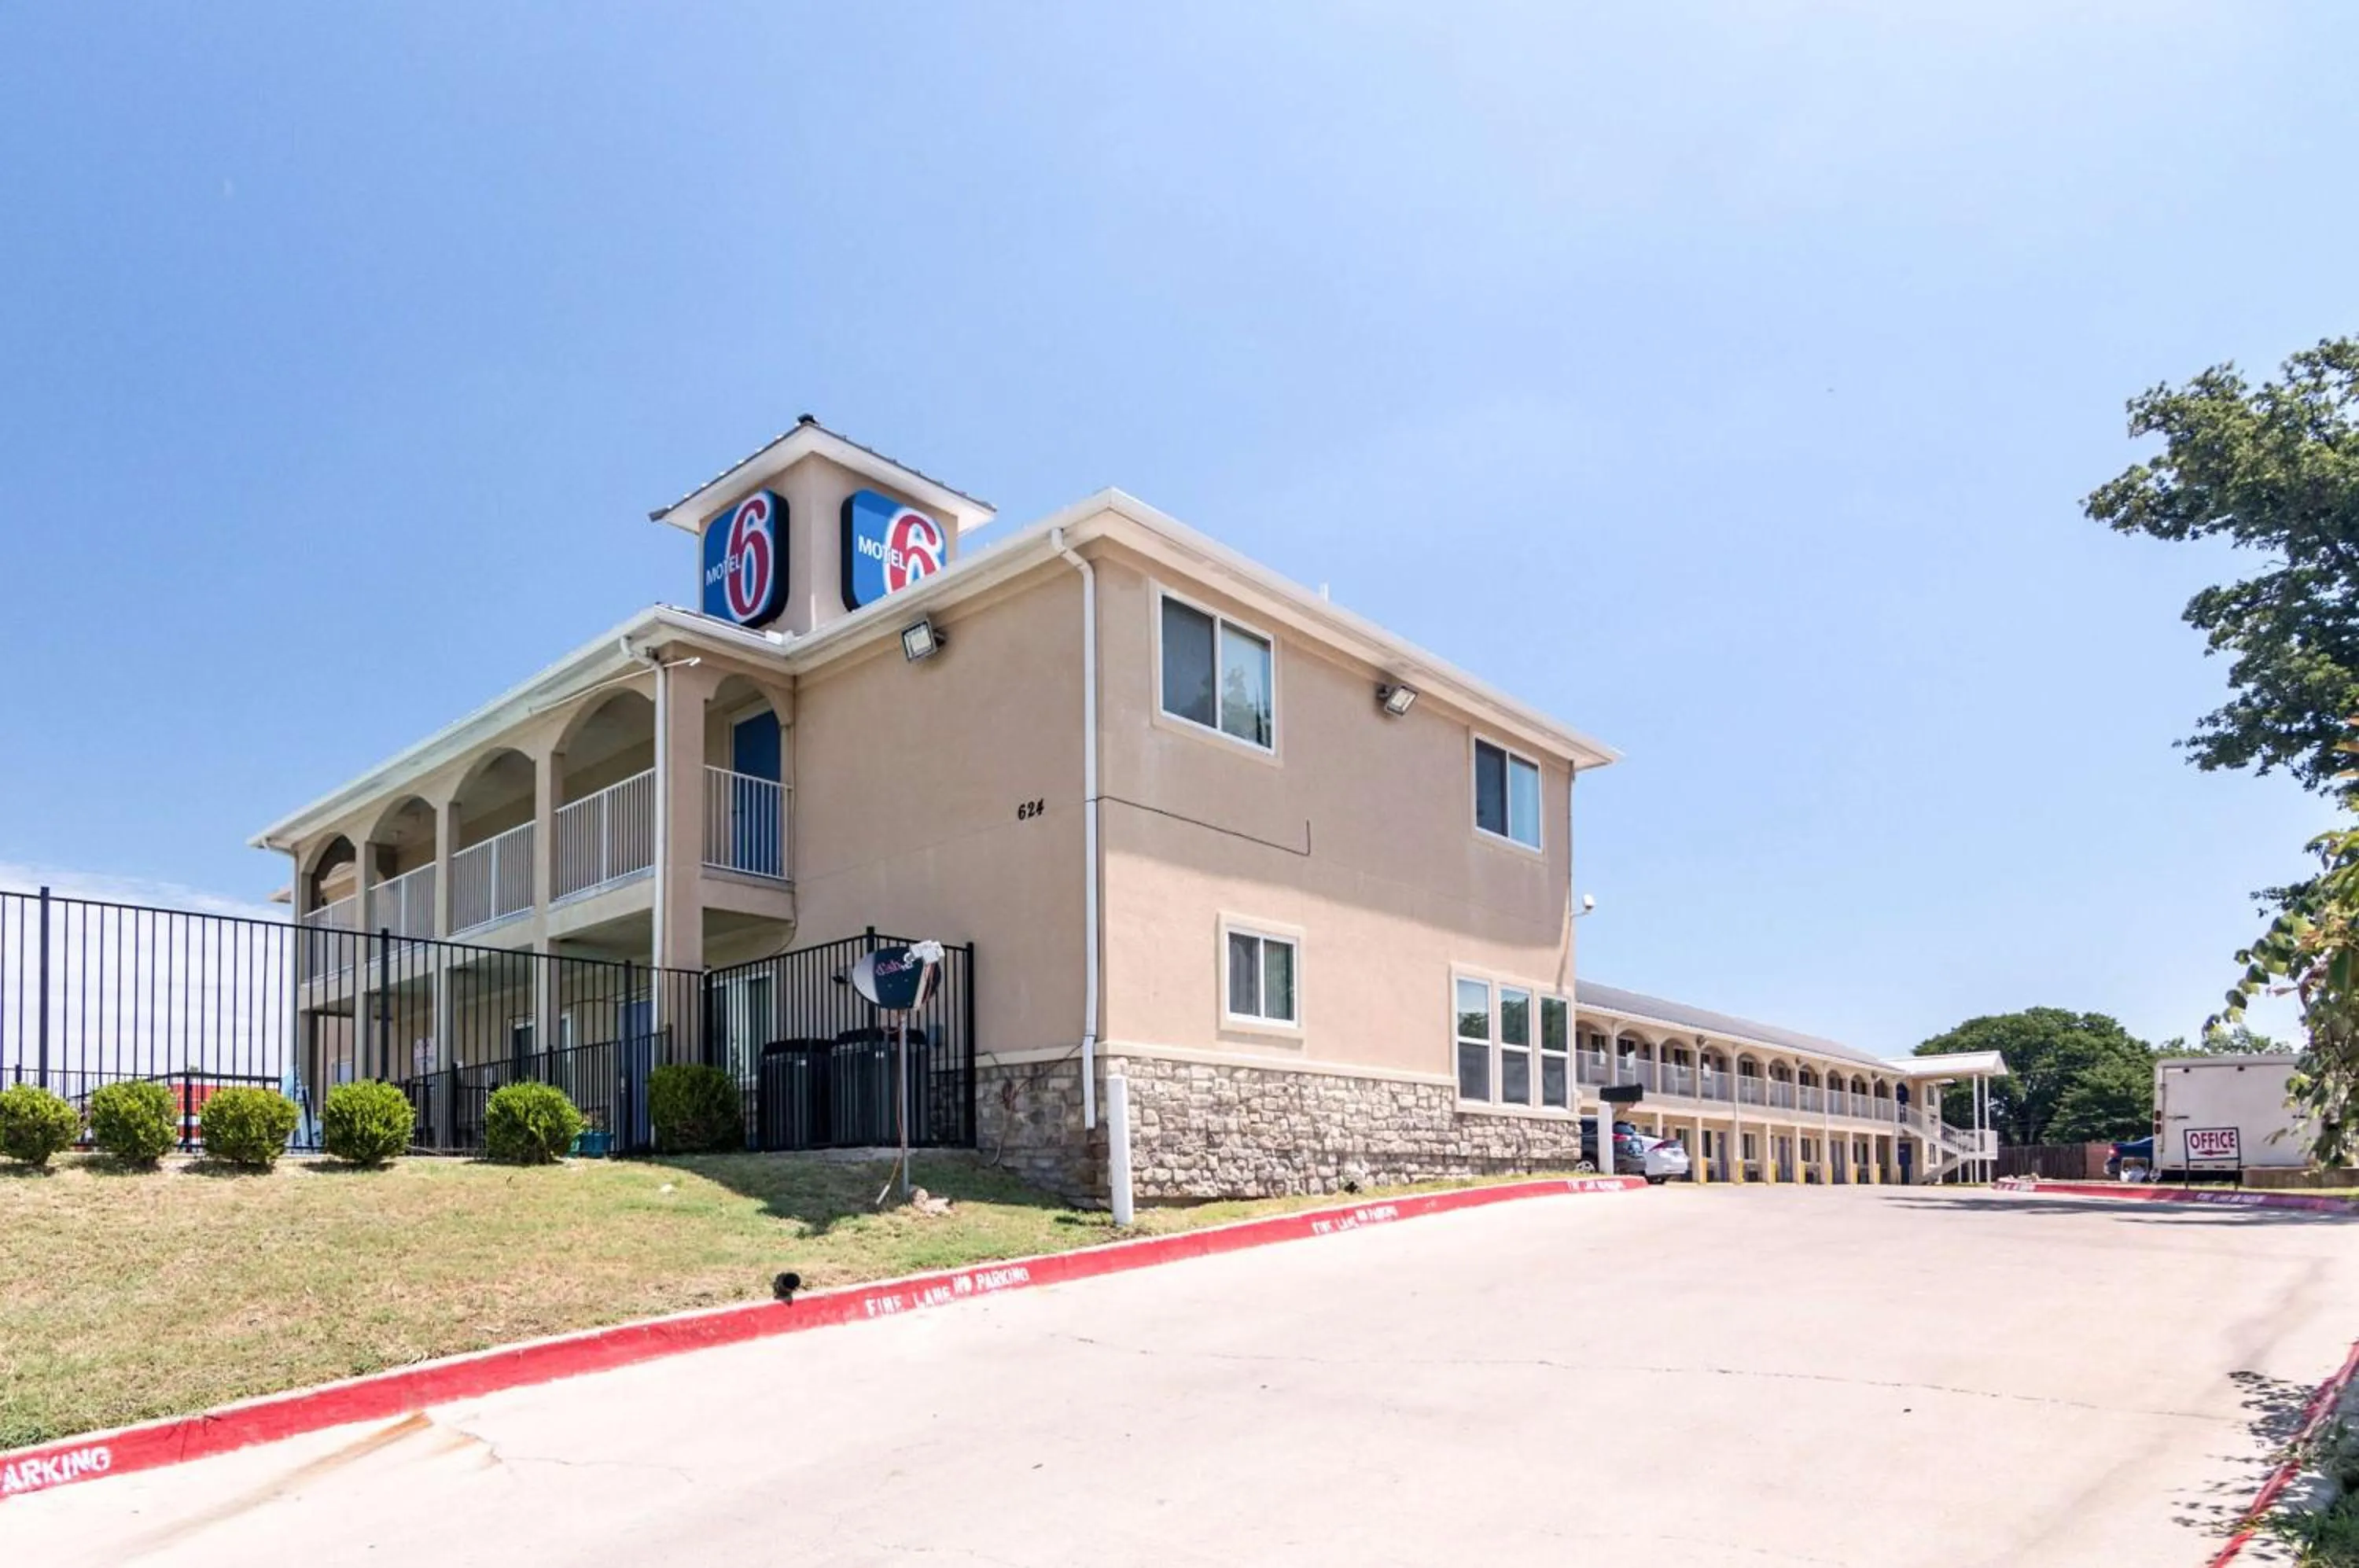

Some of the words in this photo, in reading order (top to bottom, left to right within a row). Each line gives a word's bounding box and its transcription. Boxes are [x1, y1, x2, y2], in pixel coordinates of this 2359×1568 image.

[706, 552, 742, 587] MOTEL
[725, 489, 772, 623] 6
[858, 535, 907, 570] MOTEL
[885, 506, 942, 595] 6
[1018, 798, 1044, 820] 624
[2190, 1132, 2236, 1149] OFFICE
[0, 1447, 112, 1492] ARKING
